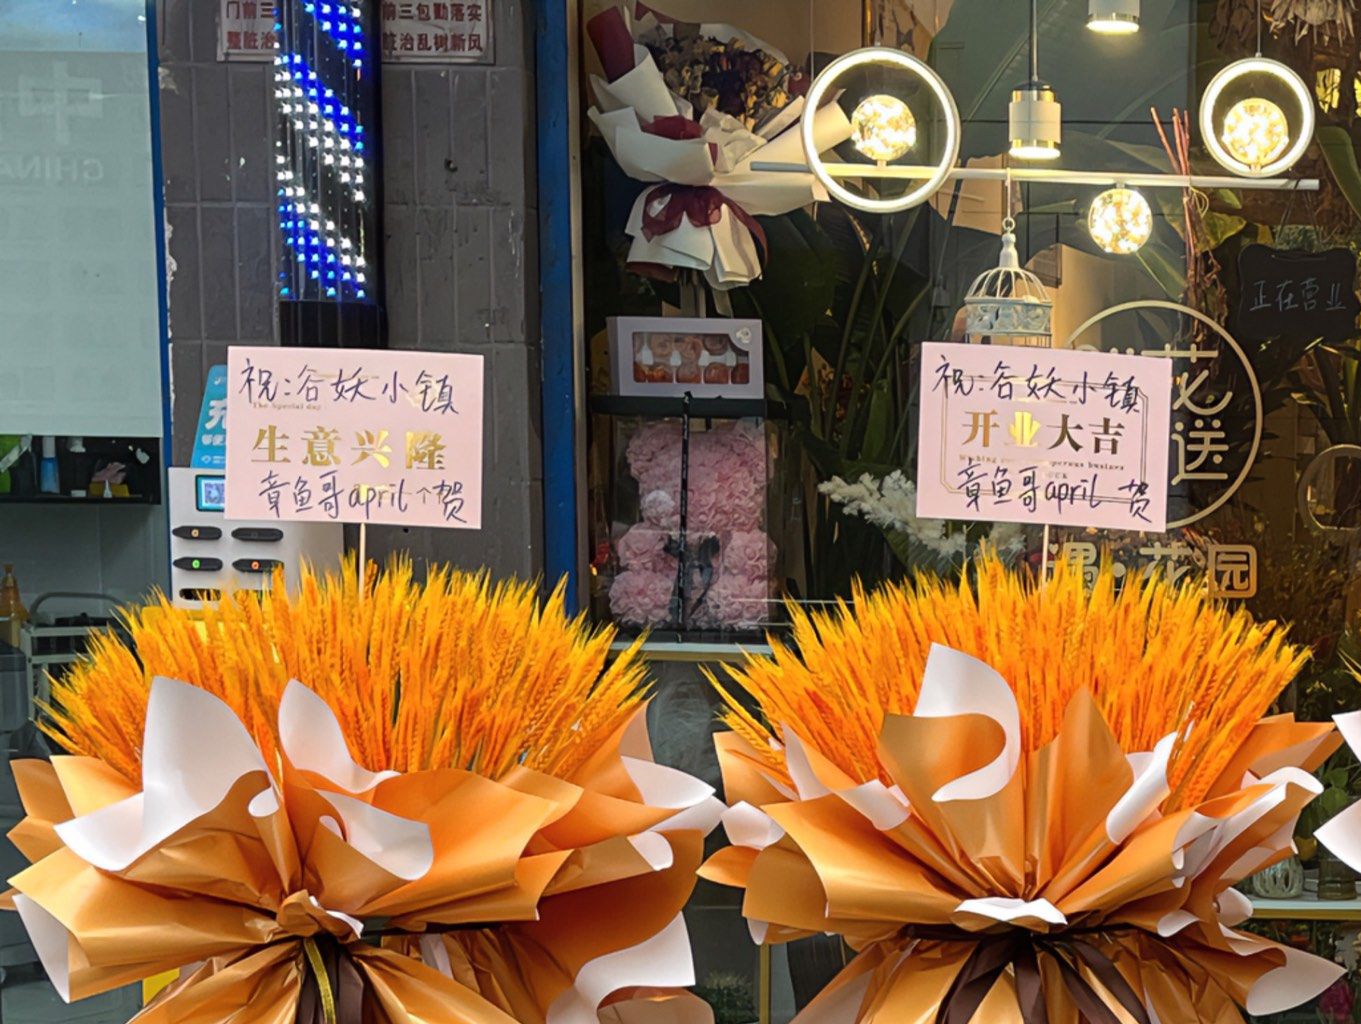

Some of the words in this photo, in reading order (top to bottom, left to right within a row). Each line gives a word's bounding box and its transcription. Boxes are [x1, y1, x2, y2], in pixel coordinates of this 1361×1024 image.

[1249, 277, 1346, 311] 正在营业
[251, 425, 447, 470] 生意兴隆
[961, 409, 1125, 455] 开业大吉
